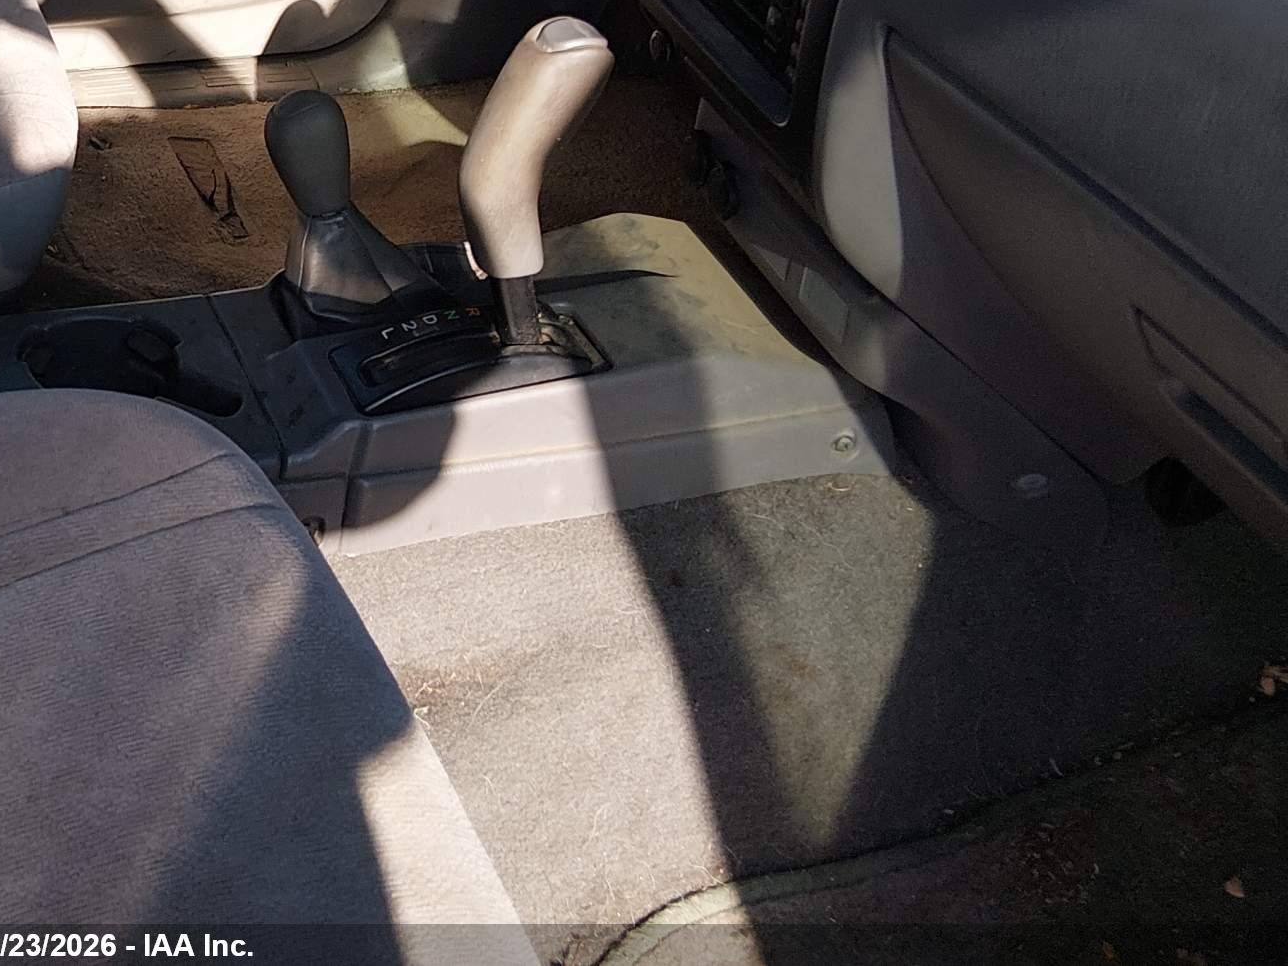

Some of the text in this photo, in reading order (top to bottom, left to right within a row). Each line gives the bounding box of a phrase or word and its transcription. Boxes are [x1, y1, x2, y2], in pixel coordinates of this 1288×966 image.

[381, 307, 481, 340] R N D 2 L
